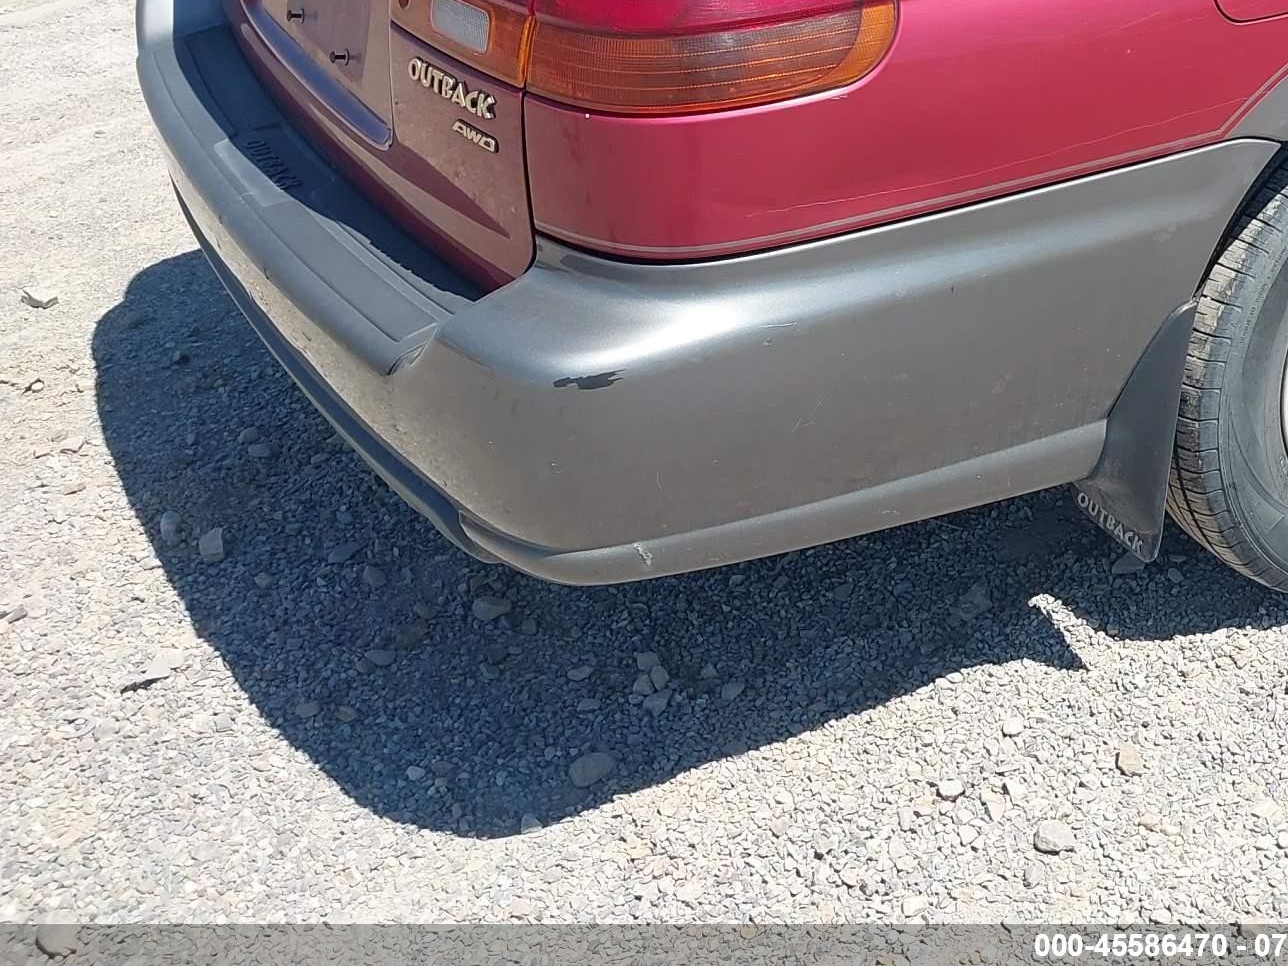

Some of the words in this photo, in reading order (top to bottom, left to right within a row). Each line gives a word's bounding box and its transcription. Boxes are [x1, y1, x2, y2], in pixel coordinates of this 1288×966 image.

[407, 56, 498, 120] OUTBACK
[452, 119, 500, 154] AWD
[1077, 491, 1144, 556] OUTBACK
